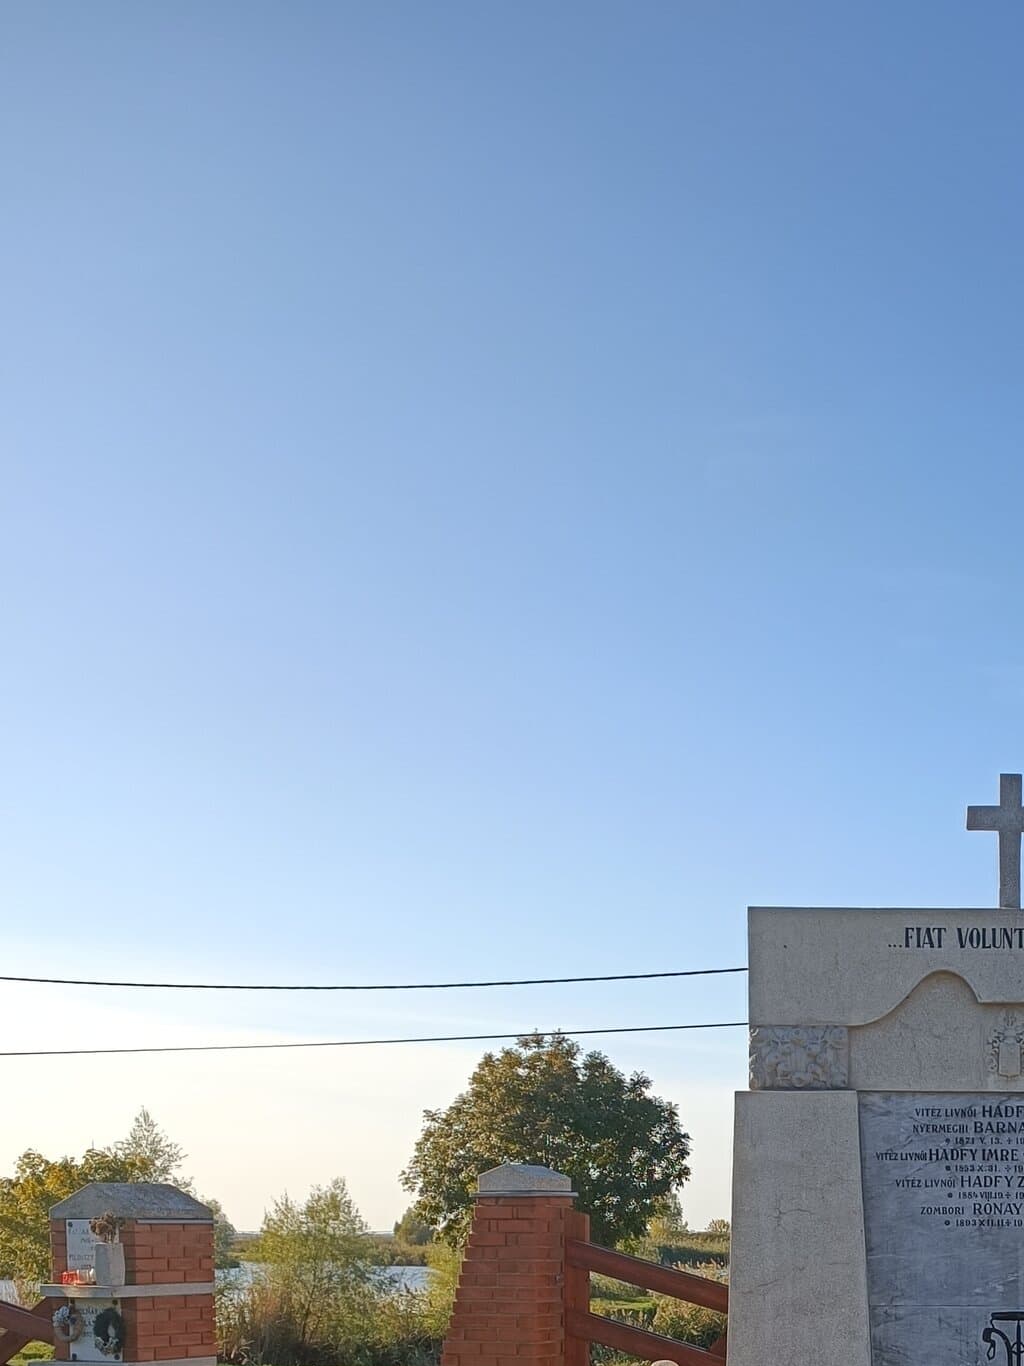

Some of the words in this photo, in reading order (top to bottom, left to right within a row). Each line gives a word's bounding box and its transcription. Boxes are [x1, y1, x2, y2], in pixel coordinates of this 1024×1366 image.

[929, 1148, 977, 1161] HADFY
[982, 1148, 1019, 1161] IMRE
[960, 1175, 1014, 1188] HADFY
[920, 1206, 965, 1215] ZOMBORI
